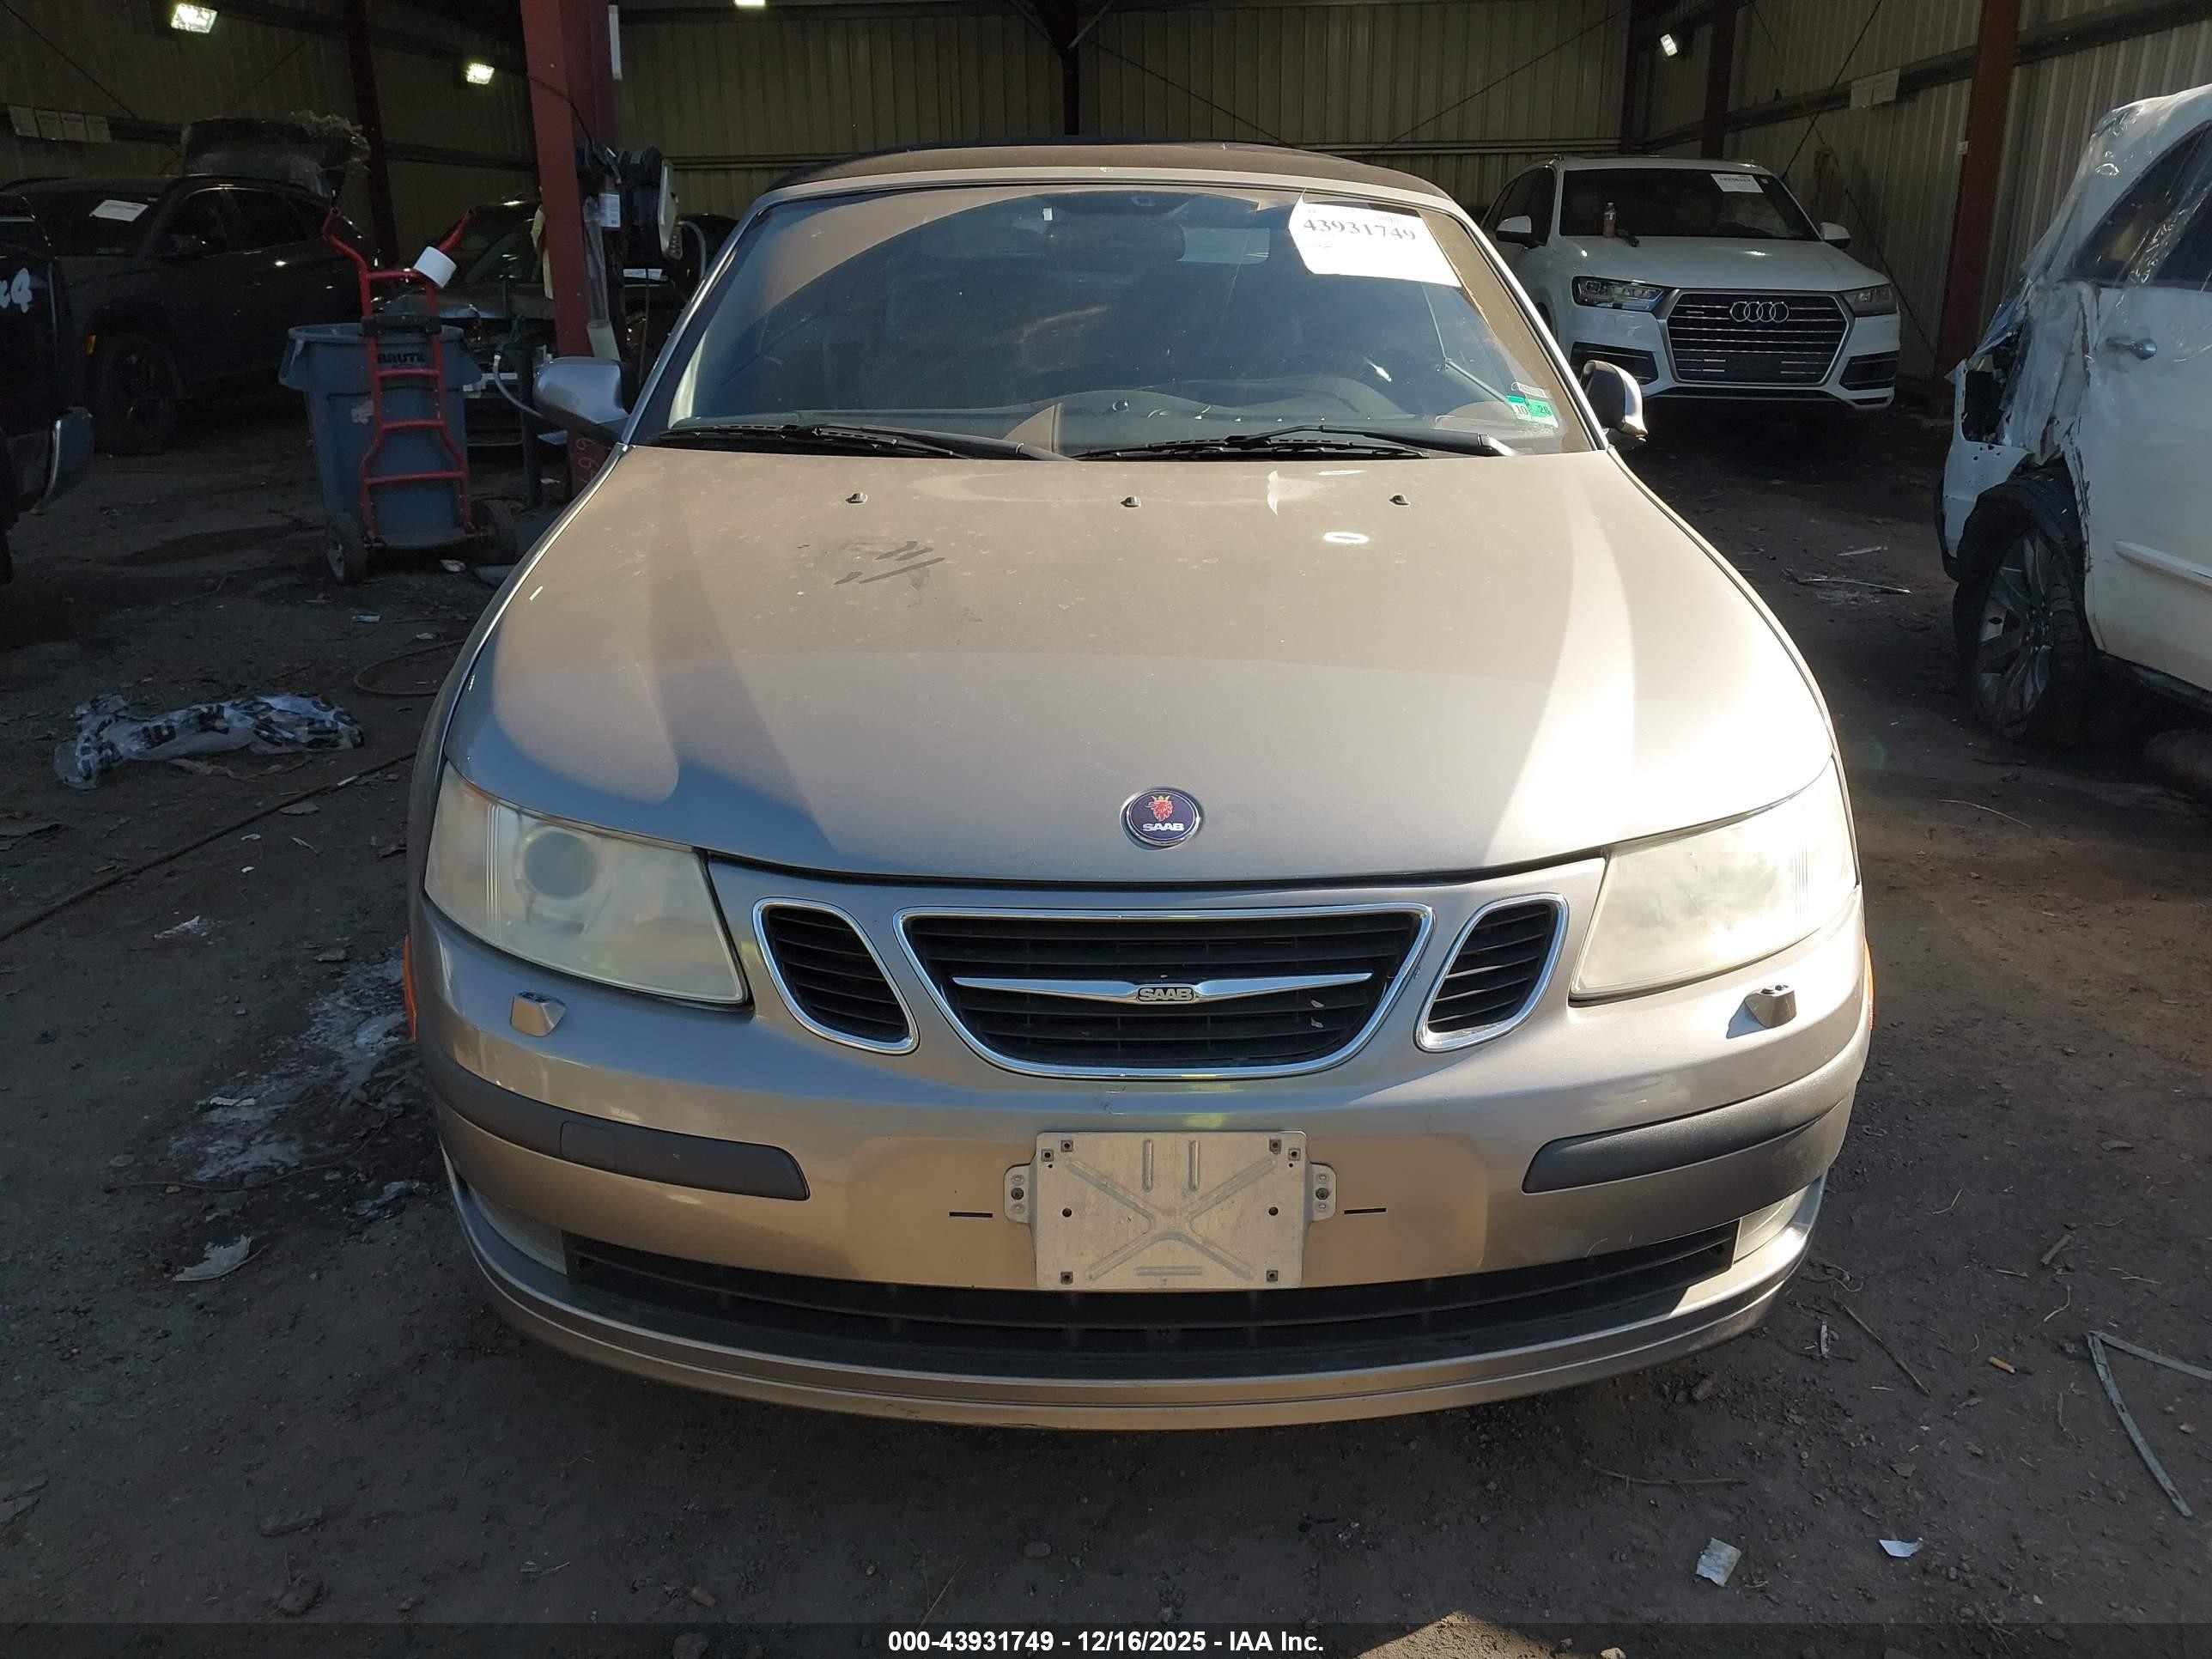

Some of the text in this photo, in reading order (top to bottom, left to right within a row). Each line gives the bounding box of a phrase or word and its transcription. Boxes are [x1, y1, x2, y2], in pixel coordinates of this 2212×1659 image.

[1303, 218, 1416, 240] 43931749
[378, 353, 425, 363] BRUTE
[1139, 988, 1192, 1001] SAAB
